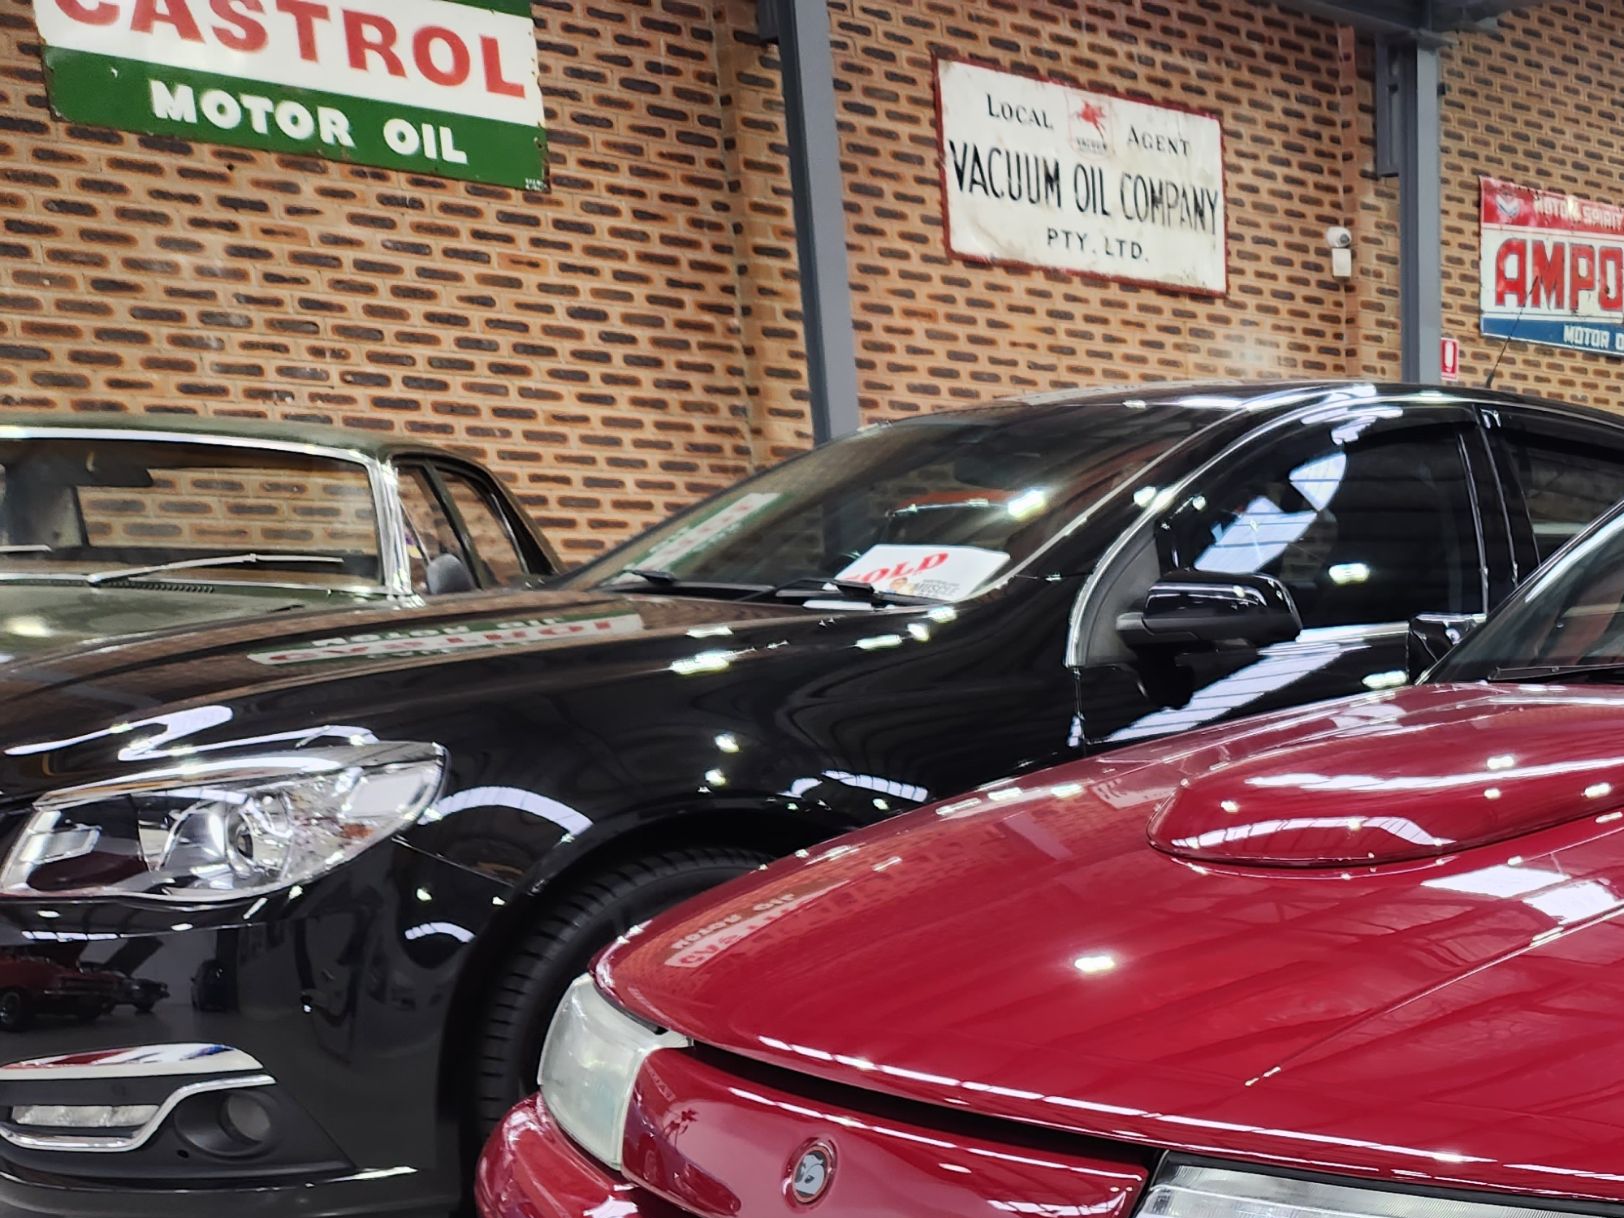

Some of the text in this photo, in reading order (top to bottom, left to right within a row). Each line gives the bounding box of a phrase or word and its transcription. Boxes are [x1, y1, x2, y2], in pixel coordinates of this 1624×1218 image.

[149, 78, 469, 165] MOTOR OIL
[985, 92, 1055, 130] LOCAL
[1127, 125, 1191, 158] AGENT
[948, 139, 1219, 236] VACUUM OIL COMPANY
[1562, 325, 1610, 348] MOTOR
